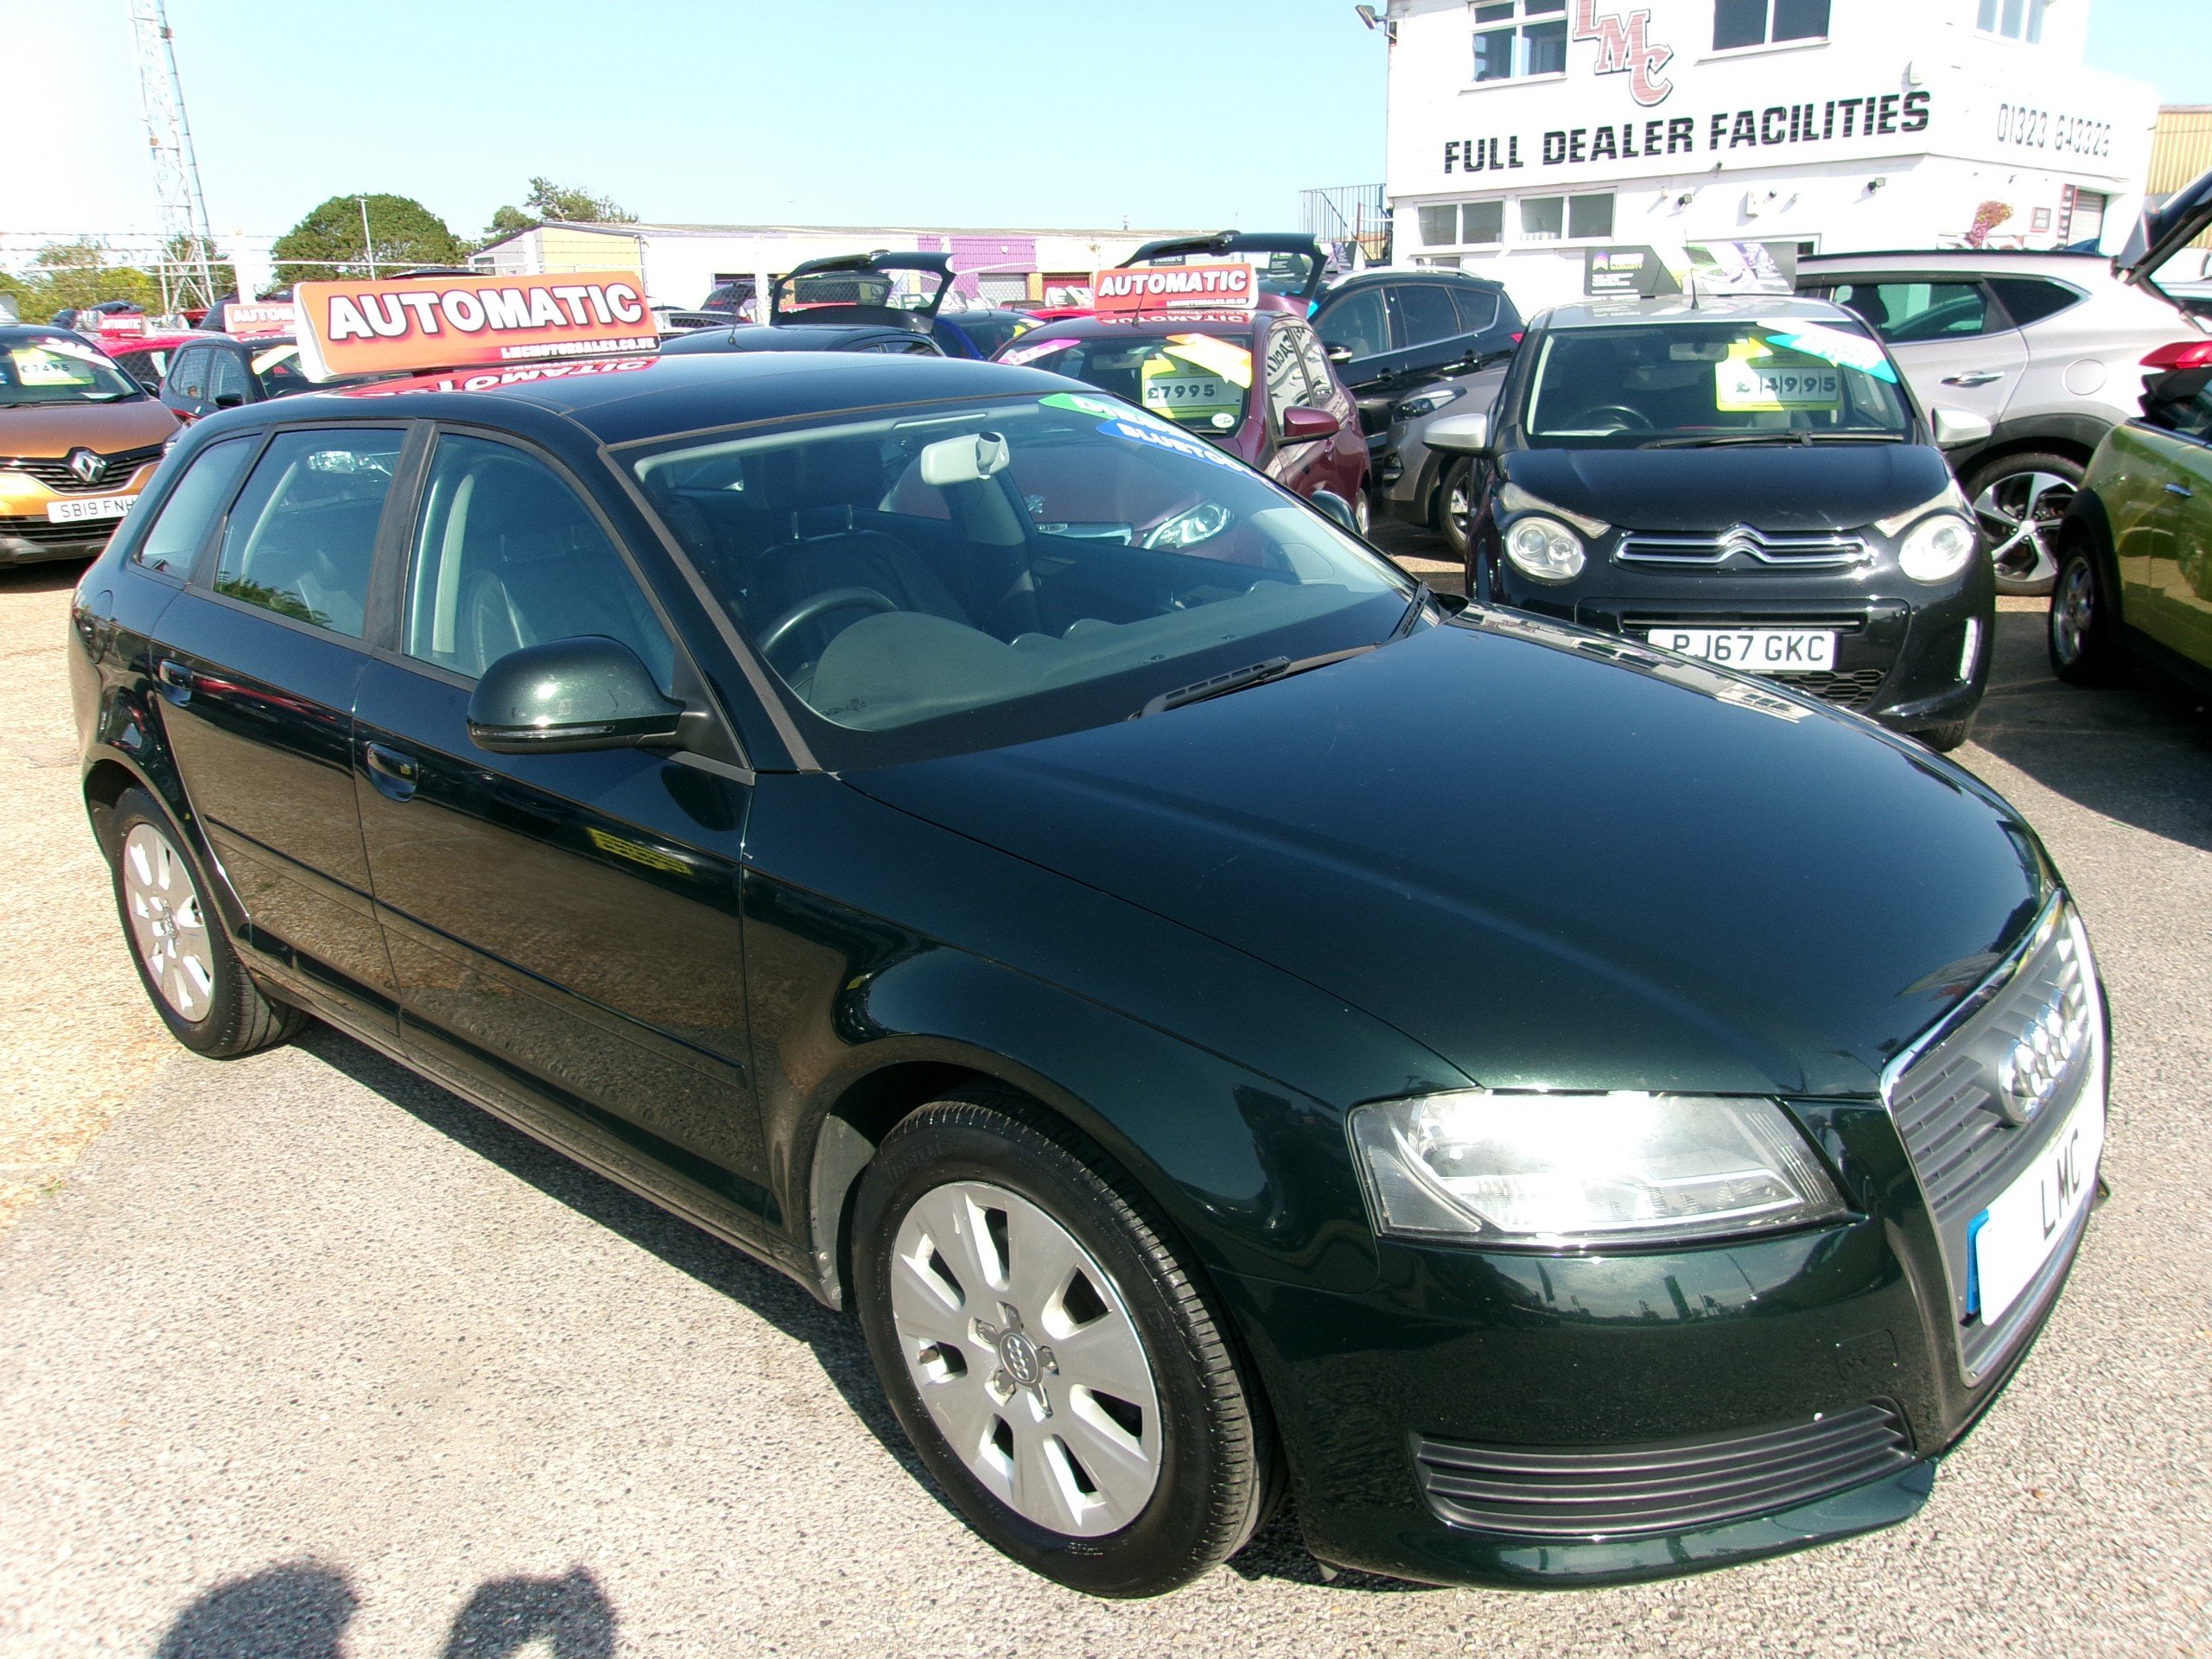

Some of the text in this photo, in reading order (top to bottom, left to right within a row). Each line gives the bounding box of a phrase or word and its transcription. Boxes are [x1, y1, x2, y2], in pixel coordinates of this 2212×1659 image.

[1573, 0, 1674, 107] LMC
[1445, 91, 1930, 174] FULL DEALER FACILITIES
[1997, 103, 2047, 149] 01323
[1097, 269, 1248, 298] AUTOMATIC
[232, 308, 295, 323] AUTOM
[328, 283, 643, 341] AUTOMATIC
[1147, 384, 1216, 399] £7995
[1116, 422, 1260, 481] BLUETOO
[60, 501, 98, 518] SB19
[1673, 633, 1825, 662] PJ67 GKC
[2040, 1128, 2081, 1241] LMC
